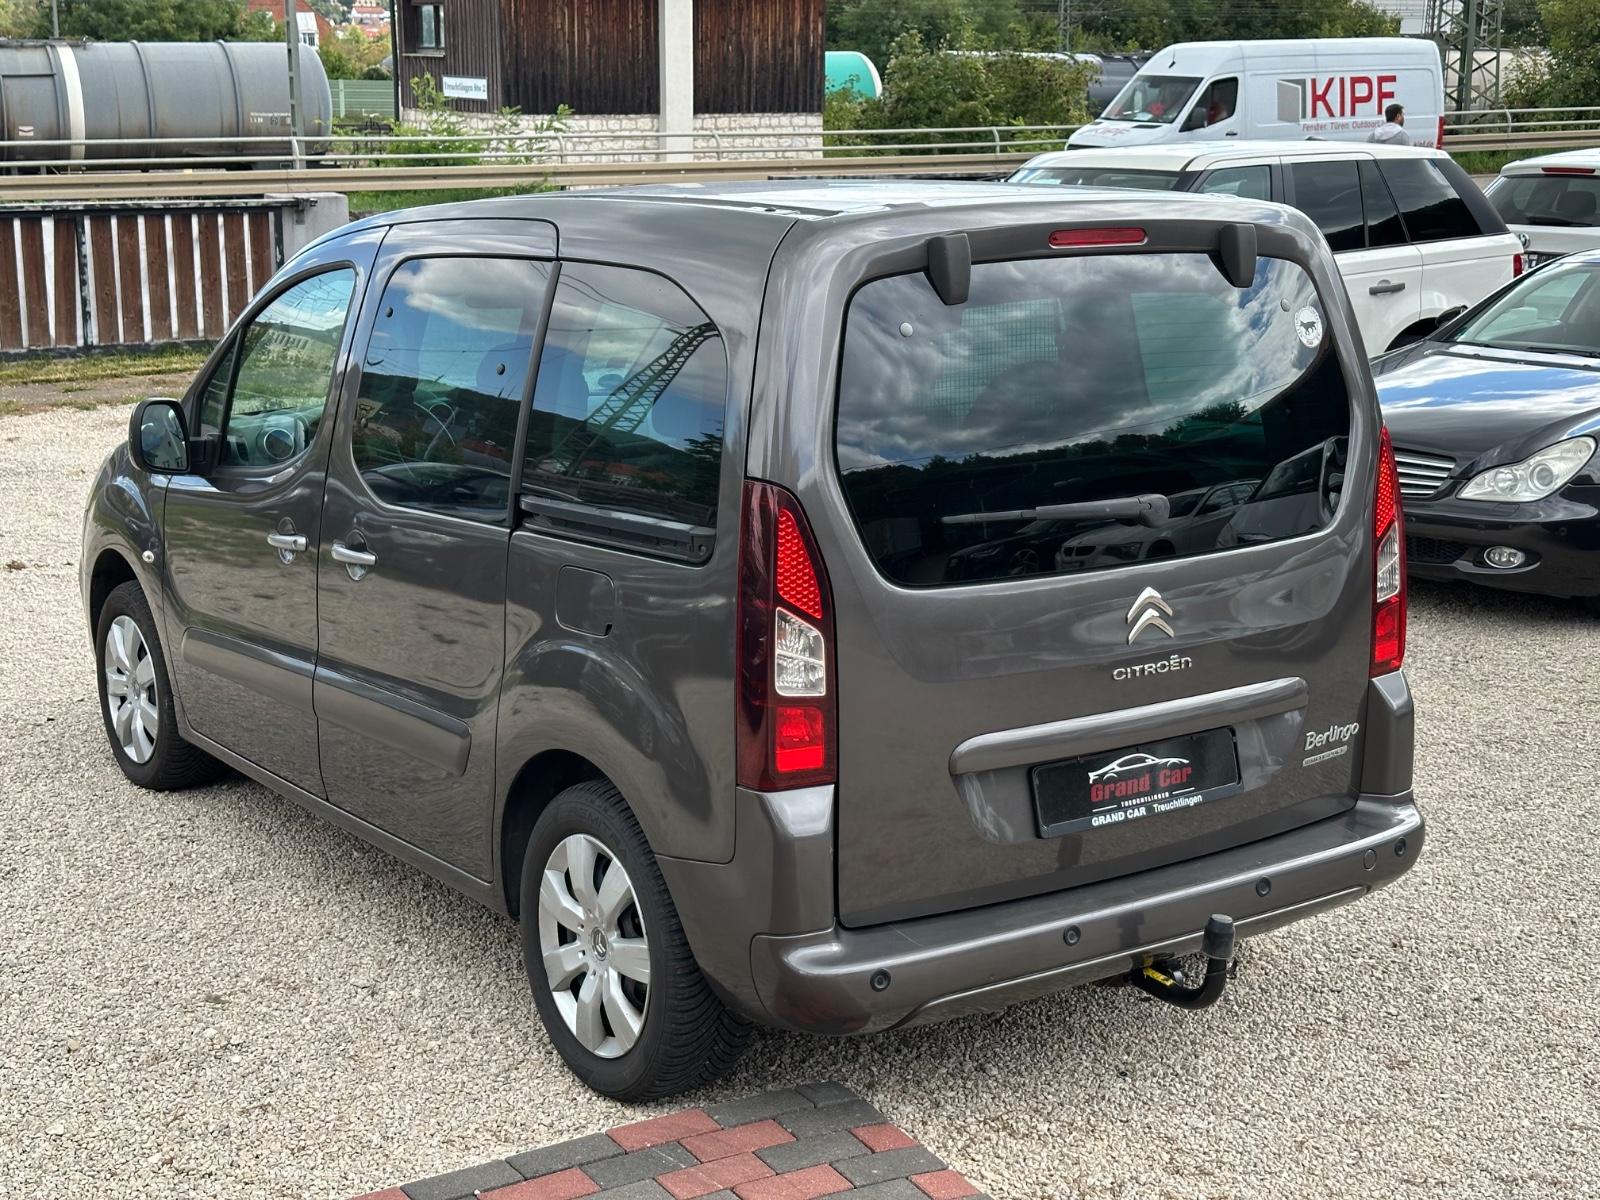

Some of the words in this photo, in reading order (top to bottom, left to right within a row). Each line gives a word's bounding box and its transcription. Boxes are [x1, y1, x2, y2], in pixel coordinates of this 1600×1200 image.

[1310, 75, 1397, 118] KIPF
[1304, 722, 1359, 751] Berlingo
[1090, 772, 1151, 803] Grand
[1158, 766, 1192, 788] Car
[1091, 811, 1126, 827] GRAND
[1126, 807, 1147, 819] CAR
[1152, 794, 1203, 813] Treuchtlingen
